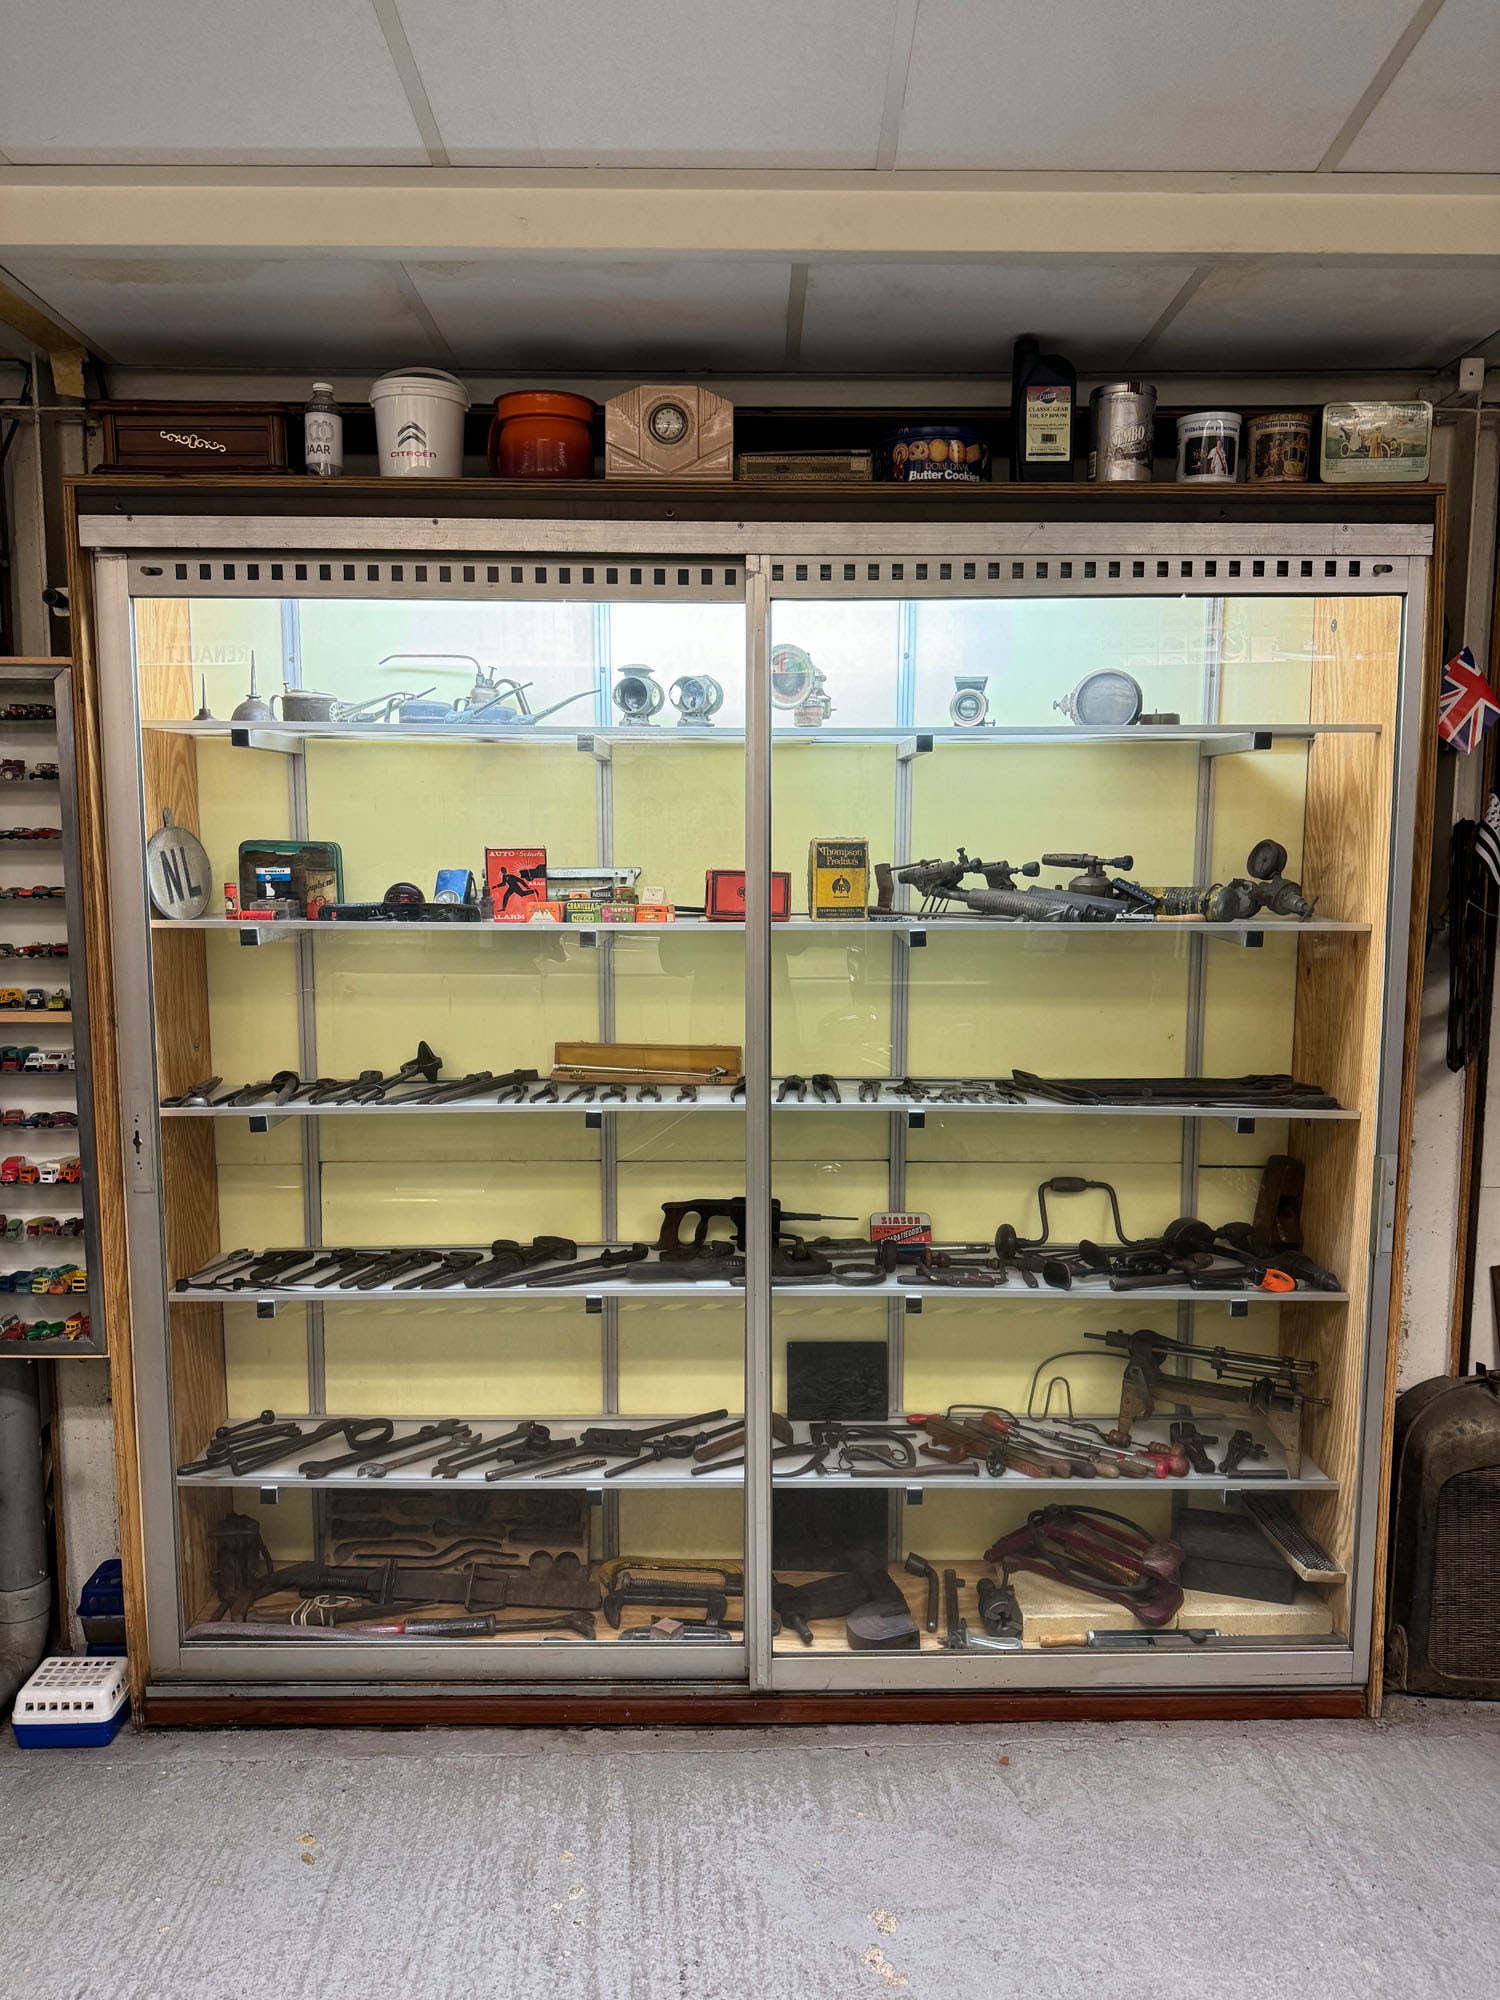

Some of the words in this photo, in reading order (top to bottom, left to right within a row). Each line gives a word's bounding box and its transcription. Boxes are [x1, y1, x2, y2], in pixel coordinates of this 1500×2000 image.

[1112, 424, 1145, 448] JUMBO
[306, 444, 331, 457] JAAR
[908, 470, 944, 482] Butter
[944, 470, 980, 482] Cookies
[819, 847, 863, 857] Thompson
[826, 857, 859, 865] Products
[160, 846, 202, 904] NL
